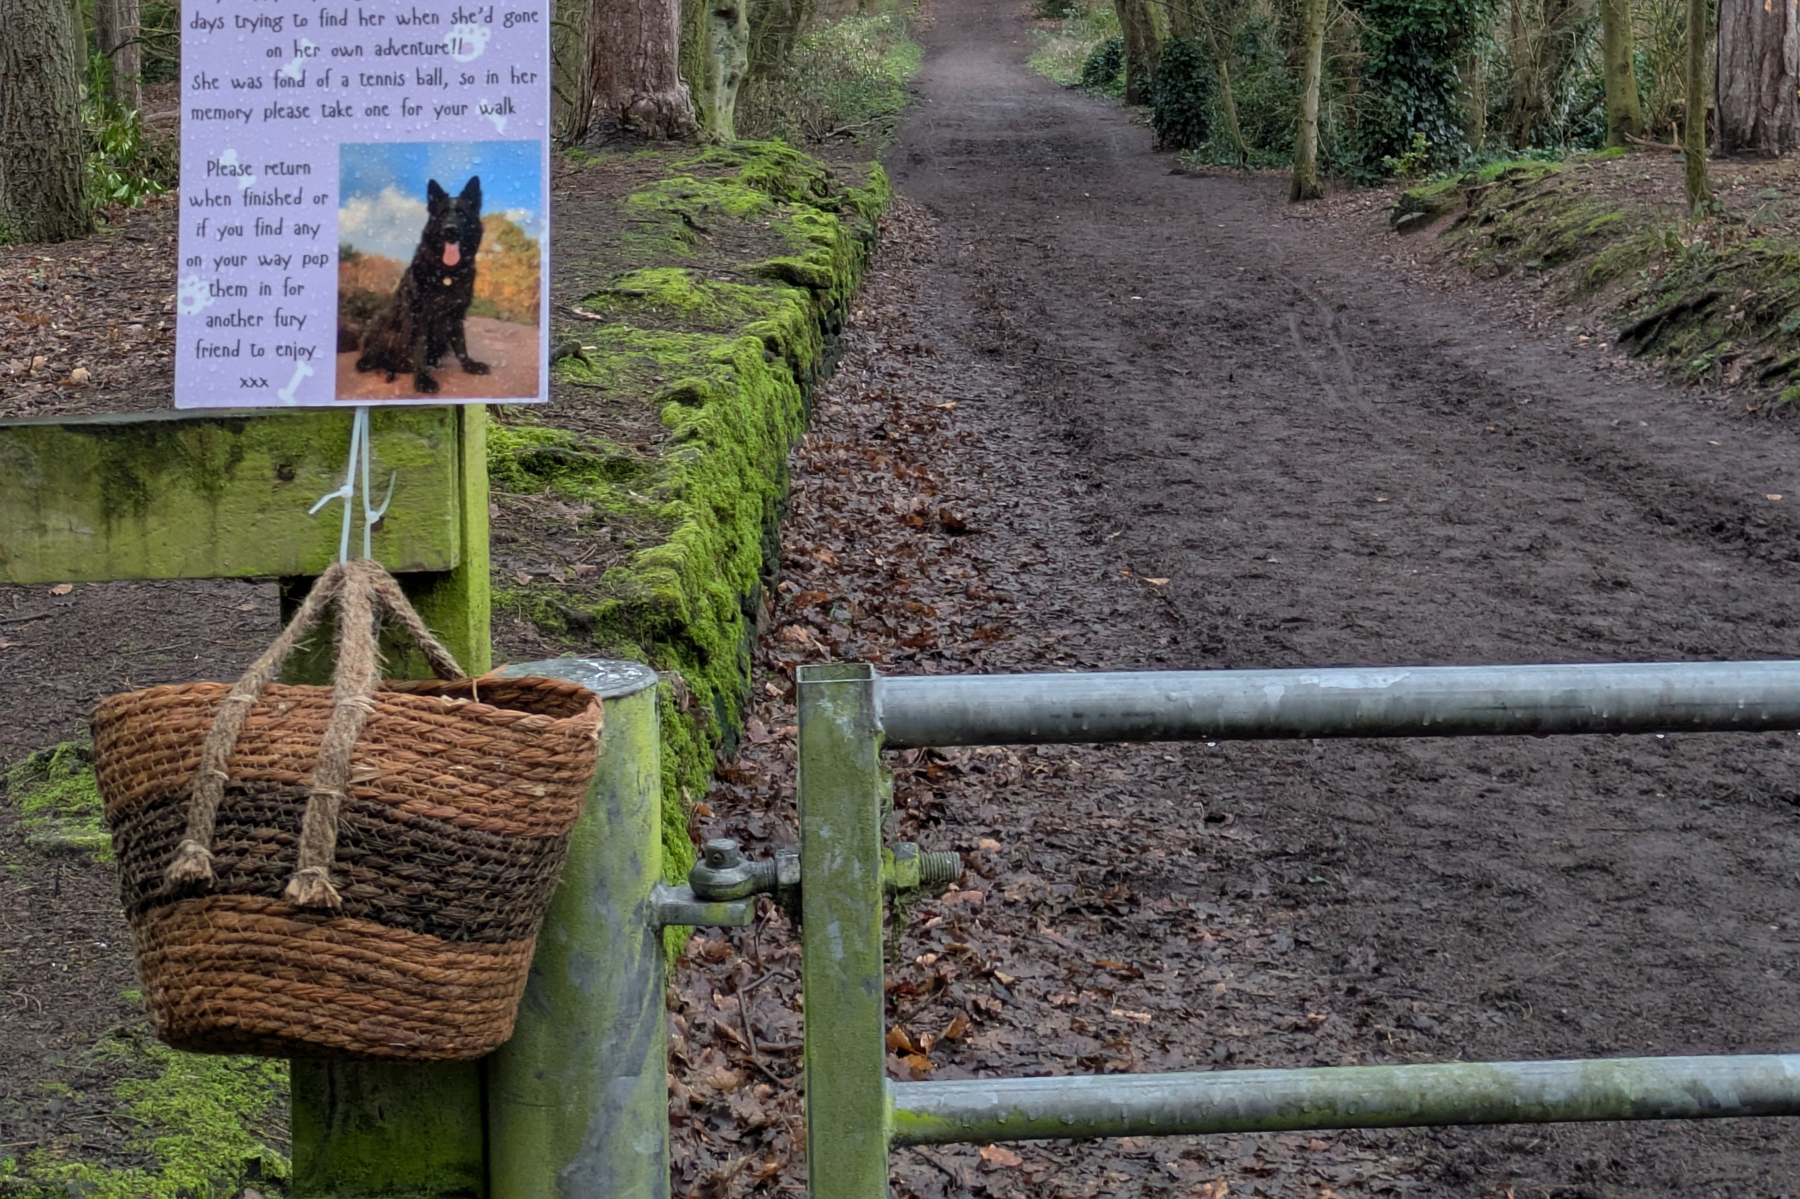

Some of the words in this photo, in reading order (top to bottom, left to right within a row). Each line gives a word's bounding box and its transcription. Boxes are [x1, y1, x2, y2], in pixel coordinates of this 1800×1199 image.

[189, 10, 225, 35] days
[234, 13, 285, 34] trying
[292, 13, 309, 28] to
[318, 7, 349, 28] find
[358, 7, 386, 27] her
[395, 6, 440, 26] when
[450, 5, 494, 26] she'd
[502, 10, 539, 28] gone
[265, 46, 283, 59] on
[293, 38, 321, 58] her
[330, 44, 364, 58] own
[374, 37, 463, 57] adventure!!
[191, 70, 220, 91] She
[230, 76, 263, 90] was
[272, 68, 307, 90] fond
[315, 67, 333, 89] of
[340, 75, 350, 88] a
[358, 71, 406, 88] tennis
[415, 66, 449, 90] ball,
[458, 72, 476, 86] so
[485, 69, 500, 85] in
[510, 65, 538, 85] her
[191, 107, 254, 125] memory
[263, 100, 311, 123] please
[320, 99, 354, 119] take
[364, 104, 390, 117] one
[400, 97, 424, 118] for
[433, 104, 469, 121] your
[479, 97, 517, 116] walk
[206, 158, 253, 178] Please
[264, 161, 312, 176] return
[188, 187, 232, 208] when
[242, 186, 303, 208] finished
[312, 193, 329, 206] or
[196, 217, 210, 238] if
[216, 225, 244, 242] you
[253, 216, 284, 238] find
[293, 223, 321, 241] any
[186, 255, 203, 268] on
[212, 254, 248, 273] your
[257, 253, 293, 271] way
[208, 278, 248, 298] them
[258, 281, 272, 297] in
[282, 276, 305, 298] for
[205, 308, 264, 329] another
[273, 306, 308, 332] fury
[194, 338, 241, 360] friend
[249, 342, 266, 358] to
[275, 341, 317, 362] enjoy
[239, 376, 270, 389] xxx
